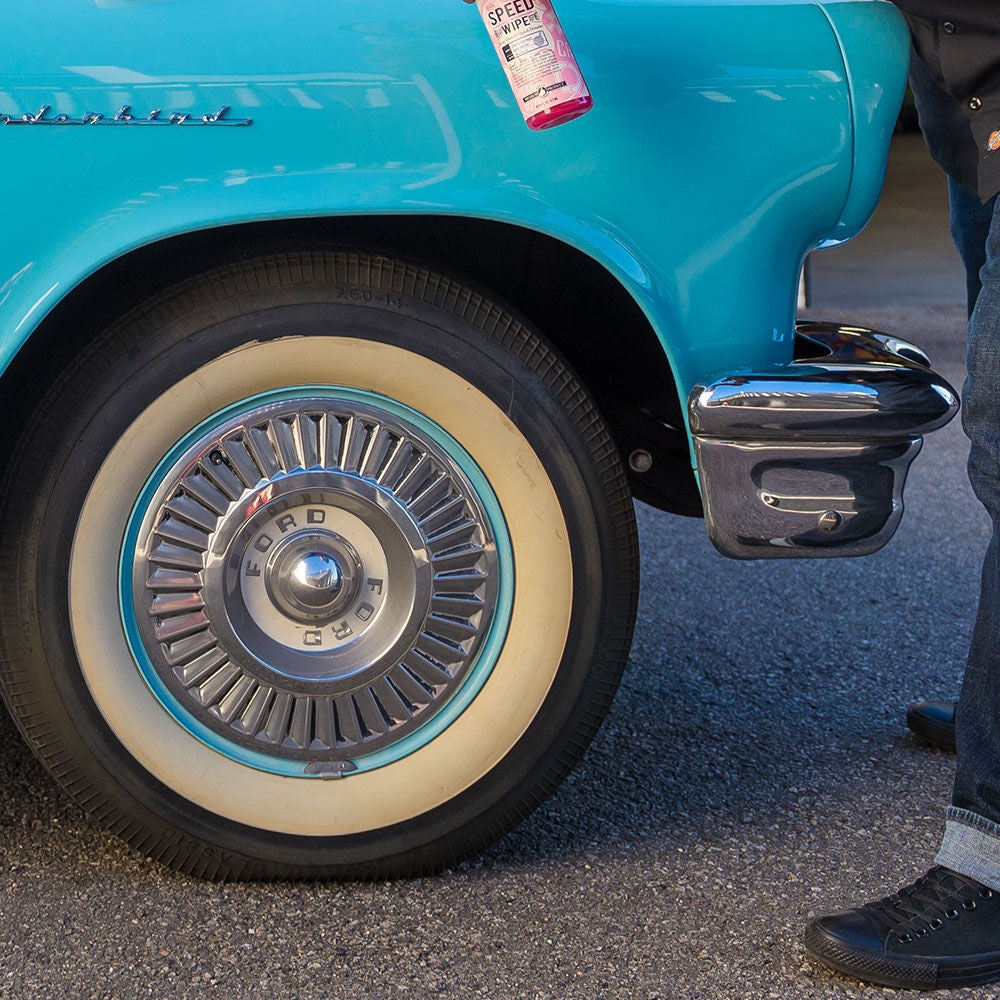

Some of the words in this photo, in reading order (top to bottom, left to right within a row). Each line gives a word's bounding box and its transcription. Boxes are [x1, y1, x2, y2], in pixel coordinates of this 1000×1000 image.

[501, 14, 531, 35] WIPE
[245, 509, 326, 577] FORD
[303, 577, 384, 646] FORD
